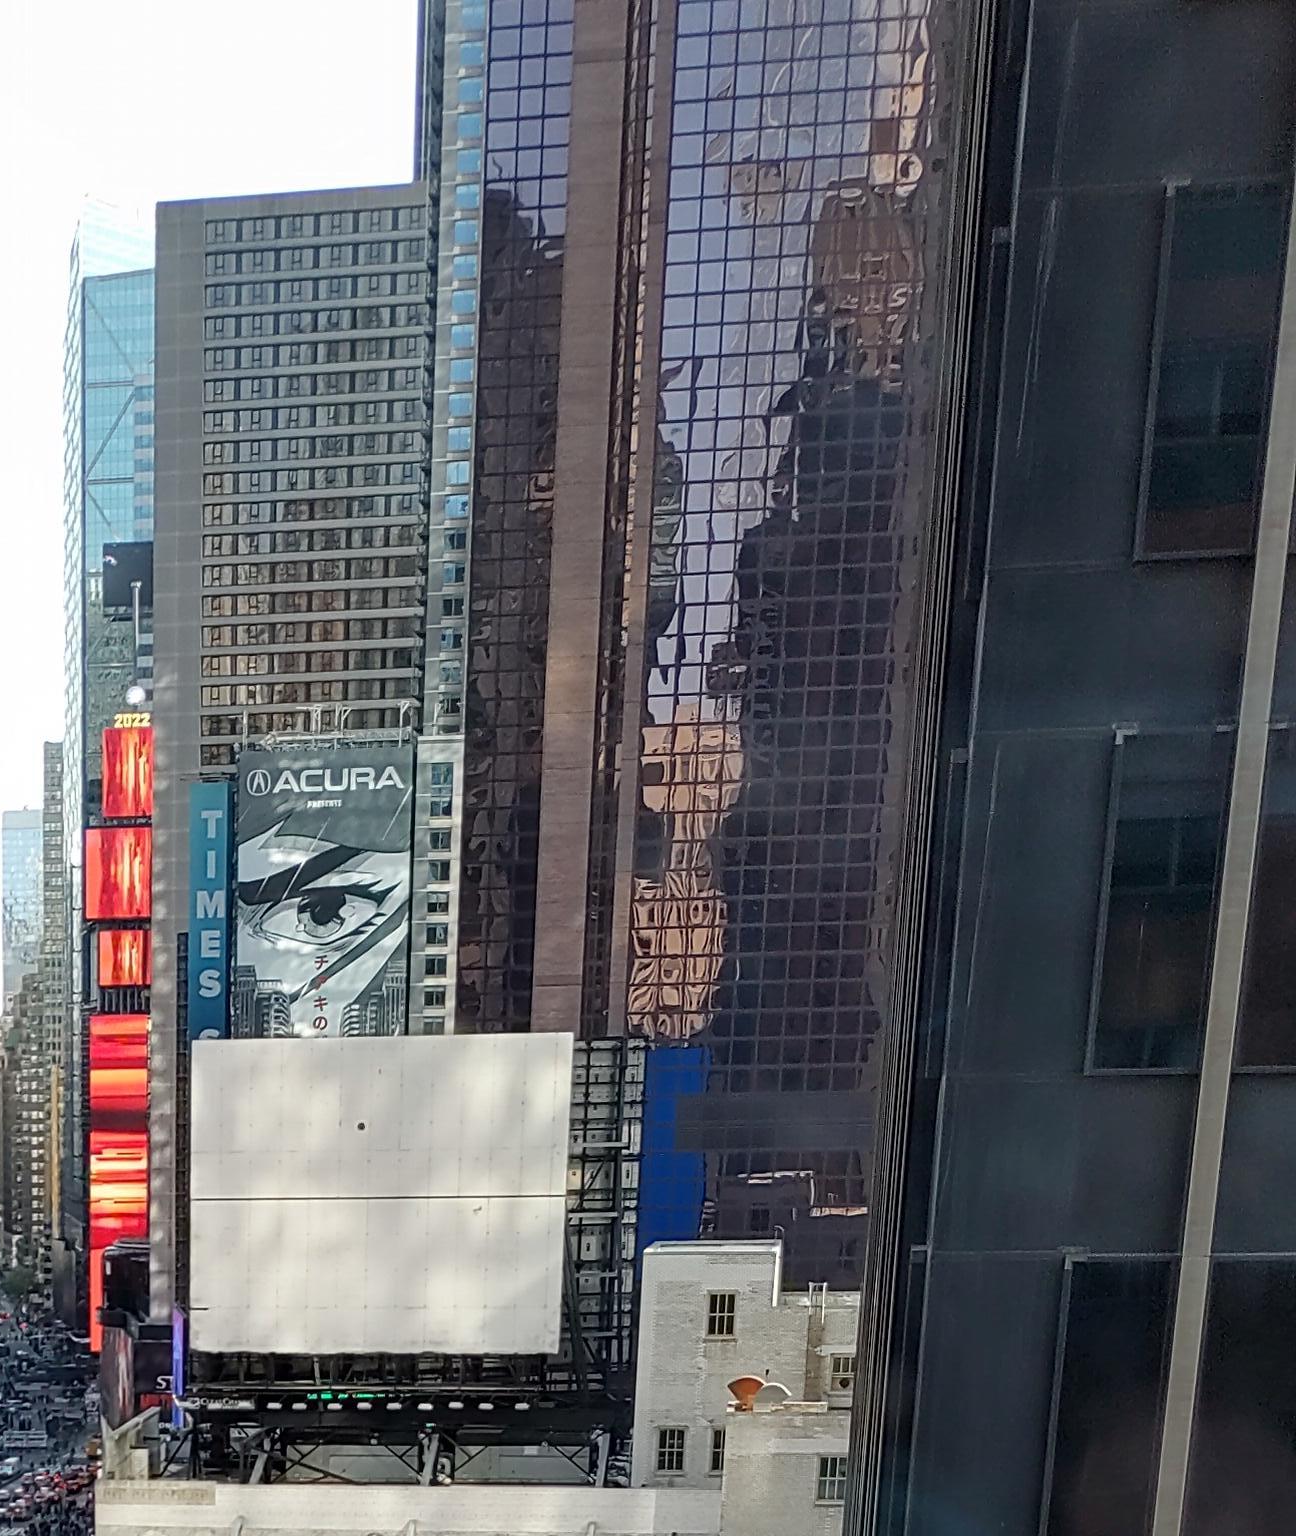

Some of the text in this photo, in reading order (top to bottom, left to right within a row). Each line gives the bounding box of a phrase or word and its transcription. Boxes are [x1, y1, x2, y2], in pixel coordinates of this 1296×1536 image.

[114, 712, 151, 728] 2022
[272, 765, 405, 794] ACURA
[196, 809, 226, 998] TIMES
